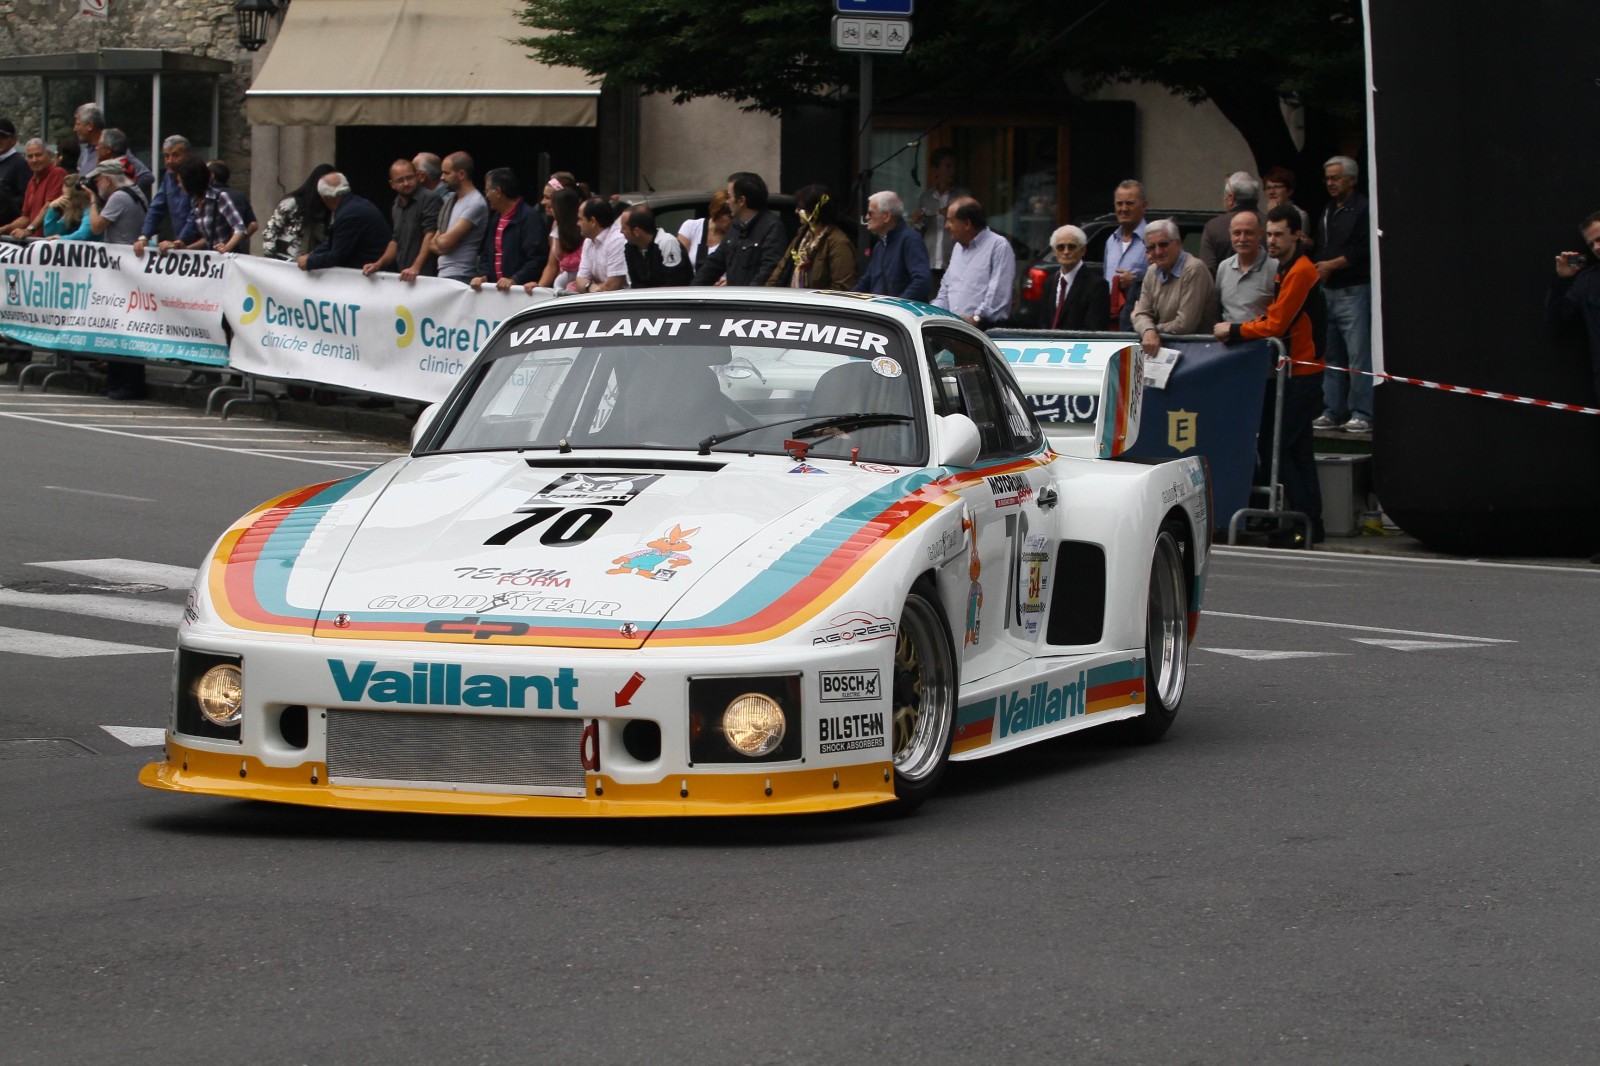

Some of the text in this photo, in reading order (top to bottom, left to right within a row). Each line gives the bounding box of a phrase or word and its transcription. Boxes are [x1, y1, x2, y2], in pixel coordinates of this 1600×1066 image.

[144, 250, 225, 279] ECOGAS Srl
[21, 269, 92, 311] Vaillant
[91, 291, 126, 308] Service
[127, 286, 158, 313] plus
[88, 316, 119, 330] CALDAIE
[126, 320, 164, 336] ENERGIE
[265, 296, 361, 337] CareDENT
[261, 330, 360, 361] cliniche dentali
[420, 317, 500, 353] CareD
[509, 317, 692, 348] VAILLANT
[718, 318, 890, 355] KREMER
[419, 355, 466, 376] clinich
[1176, 418, 1189, 442] E
[482, 507, 613, 548] 70
[496, 576, 572, 588] FORM
[424, 616, 531, 640] dp
[812, 622, 896, 646] AGOREST
[327, 658, 579, 710] Vaillant
[823, 675, 865, 693] BOSCH
[999, 670, 1086, 739] Vaillant
[819, 712, 884, 741] BILSTEIN
[821, 738, 883, 752] SHOCK ABSORBERS
